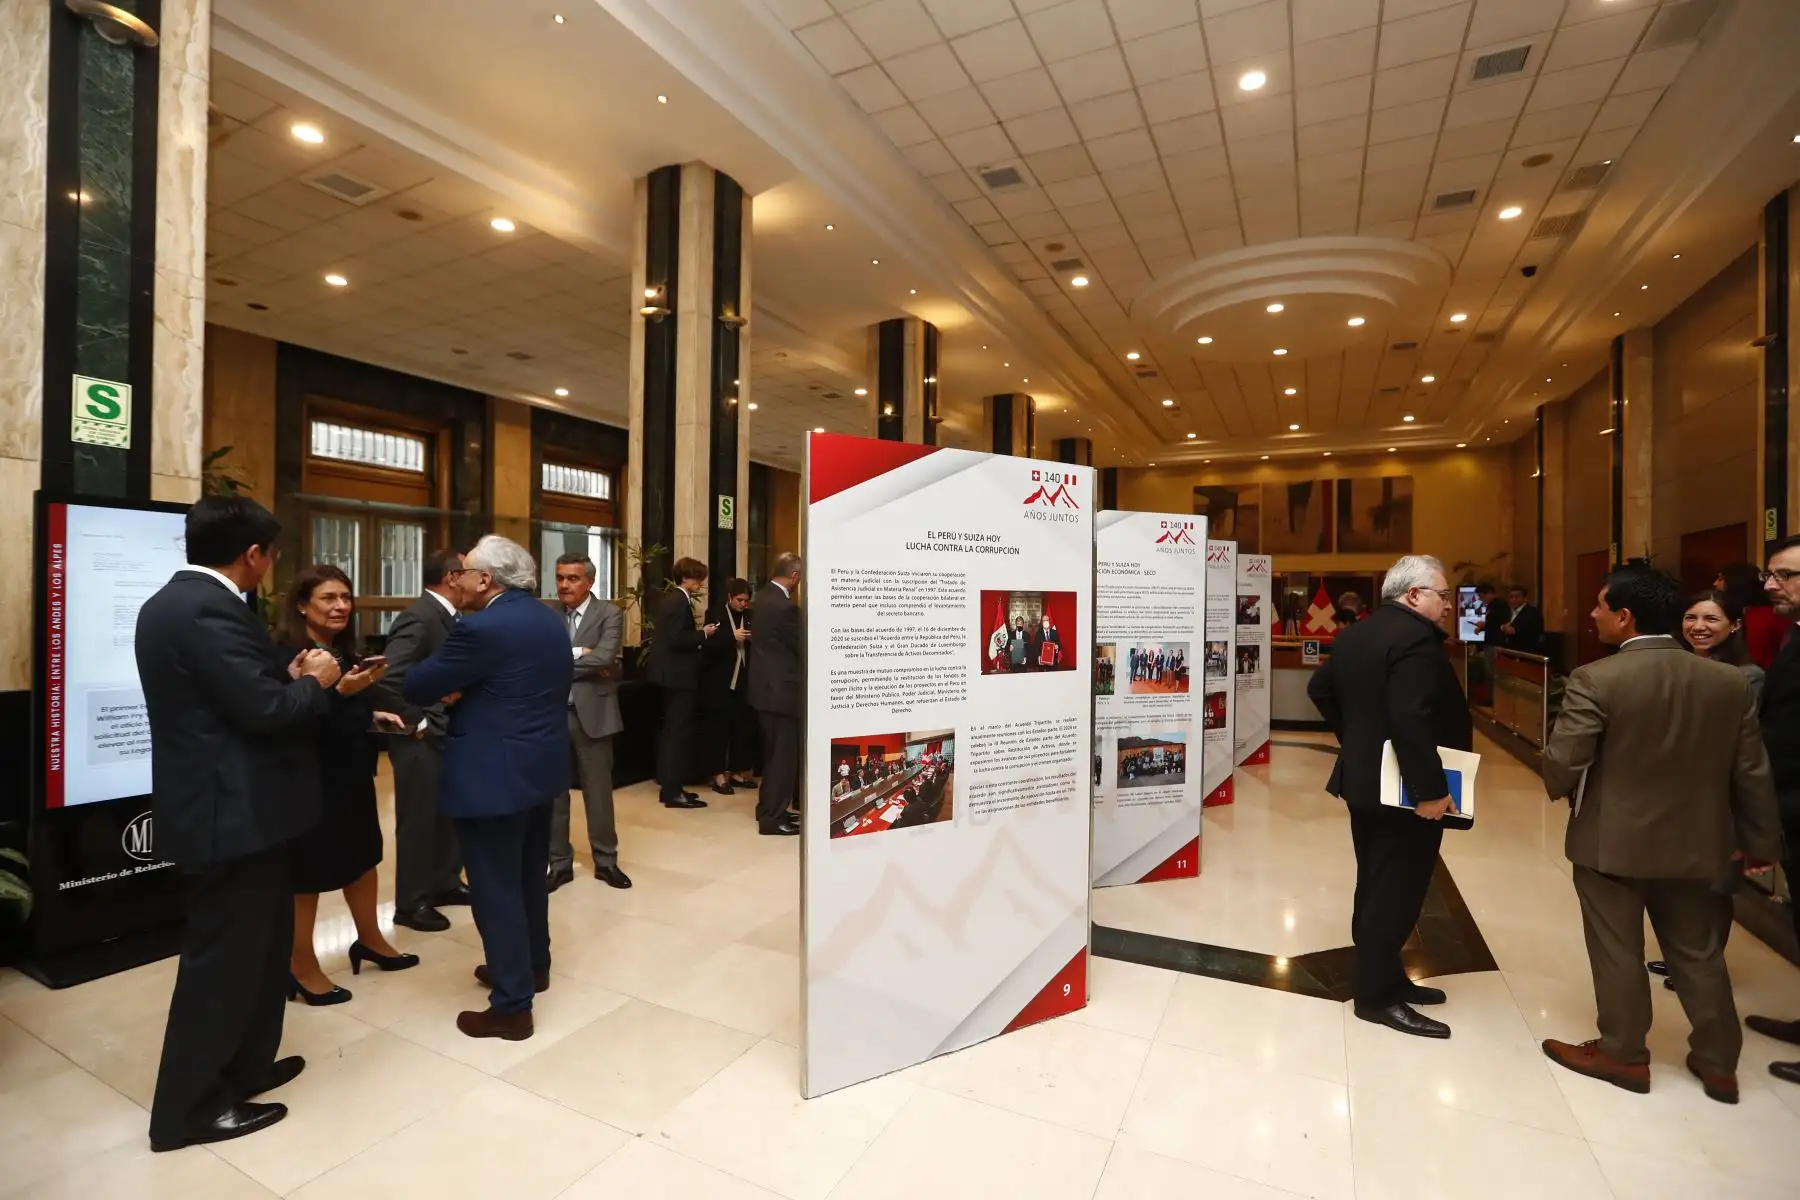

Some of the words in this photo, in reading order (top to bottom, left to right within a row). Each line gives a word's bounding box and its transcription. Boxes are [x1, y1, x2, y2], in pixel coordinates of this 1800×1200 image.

[86, 384, 121, 420] S
[1044, 472, 1060, 483] 140
[722, 498, 731, 516] S
[1024, 510, 1047, 520] AÑOS
[1048, 512, 1079, 523] JUNTOS
[1767, 511, 1775, 527] S
[927, 530, 936, 539] EL
[937, 531, 957, 540] PERÚ
[964, 533, 985, 542] SUIZA
[986, 534, 1001, 542] HOY
[906, 542, 932, 551] LUCHA
[933, 543, 963, 552] CONTRA
[975, 545, 1020, 555] CORRUPCIÓN
[1177, 860, 1187, 868] 11
[58, 872, 117, 890] Ministerio
[1063, 984, 1071, 996] 9
